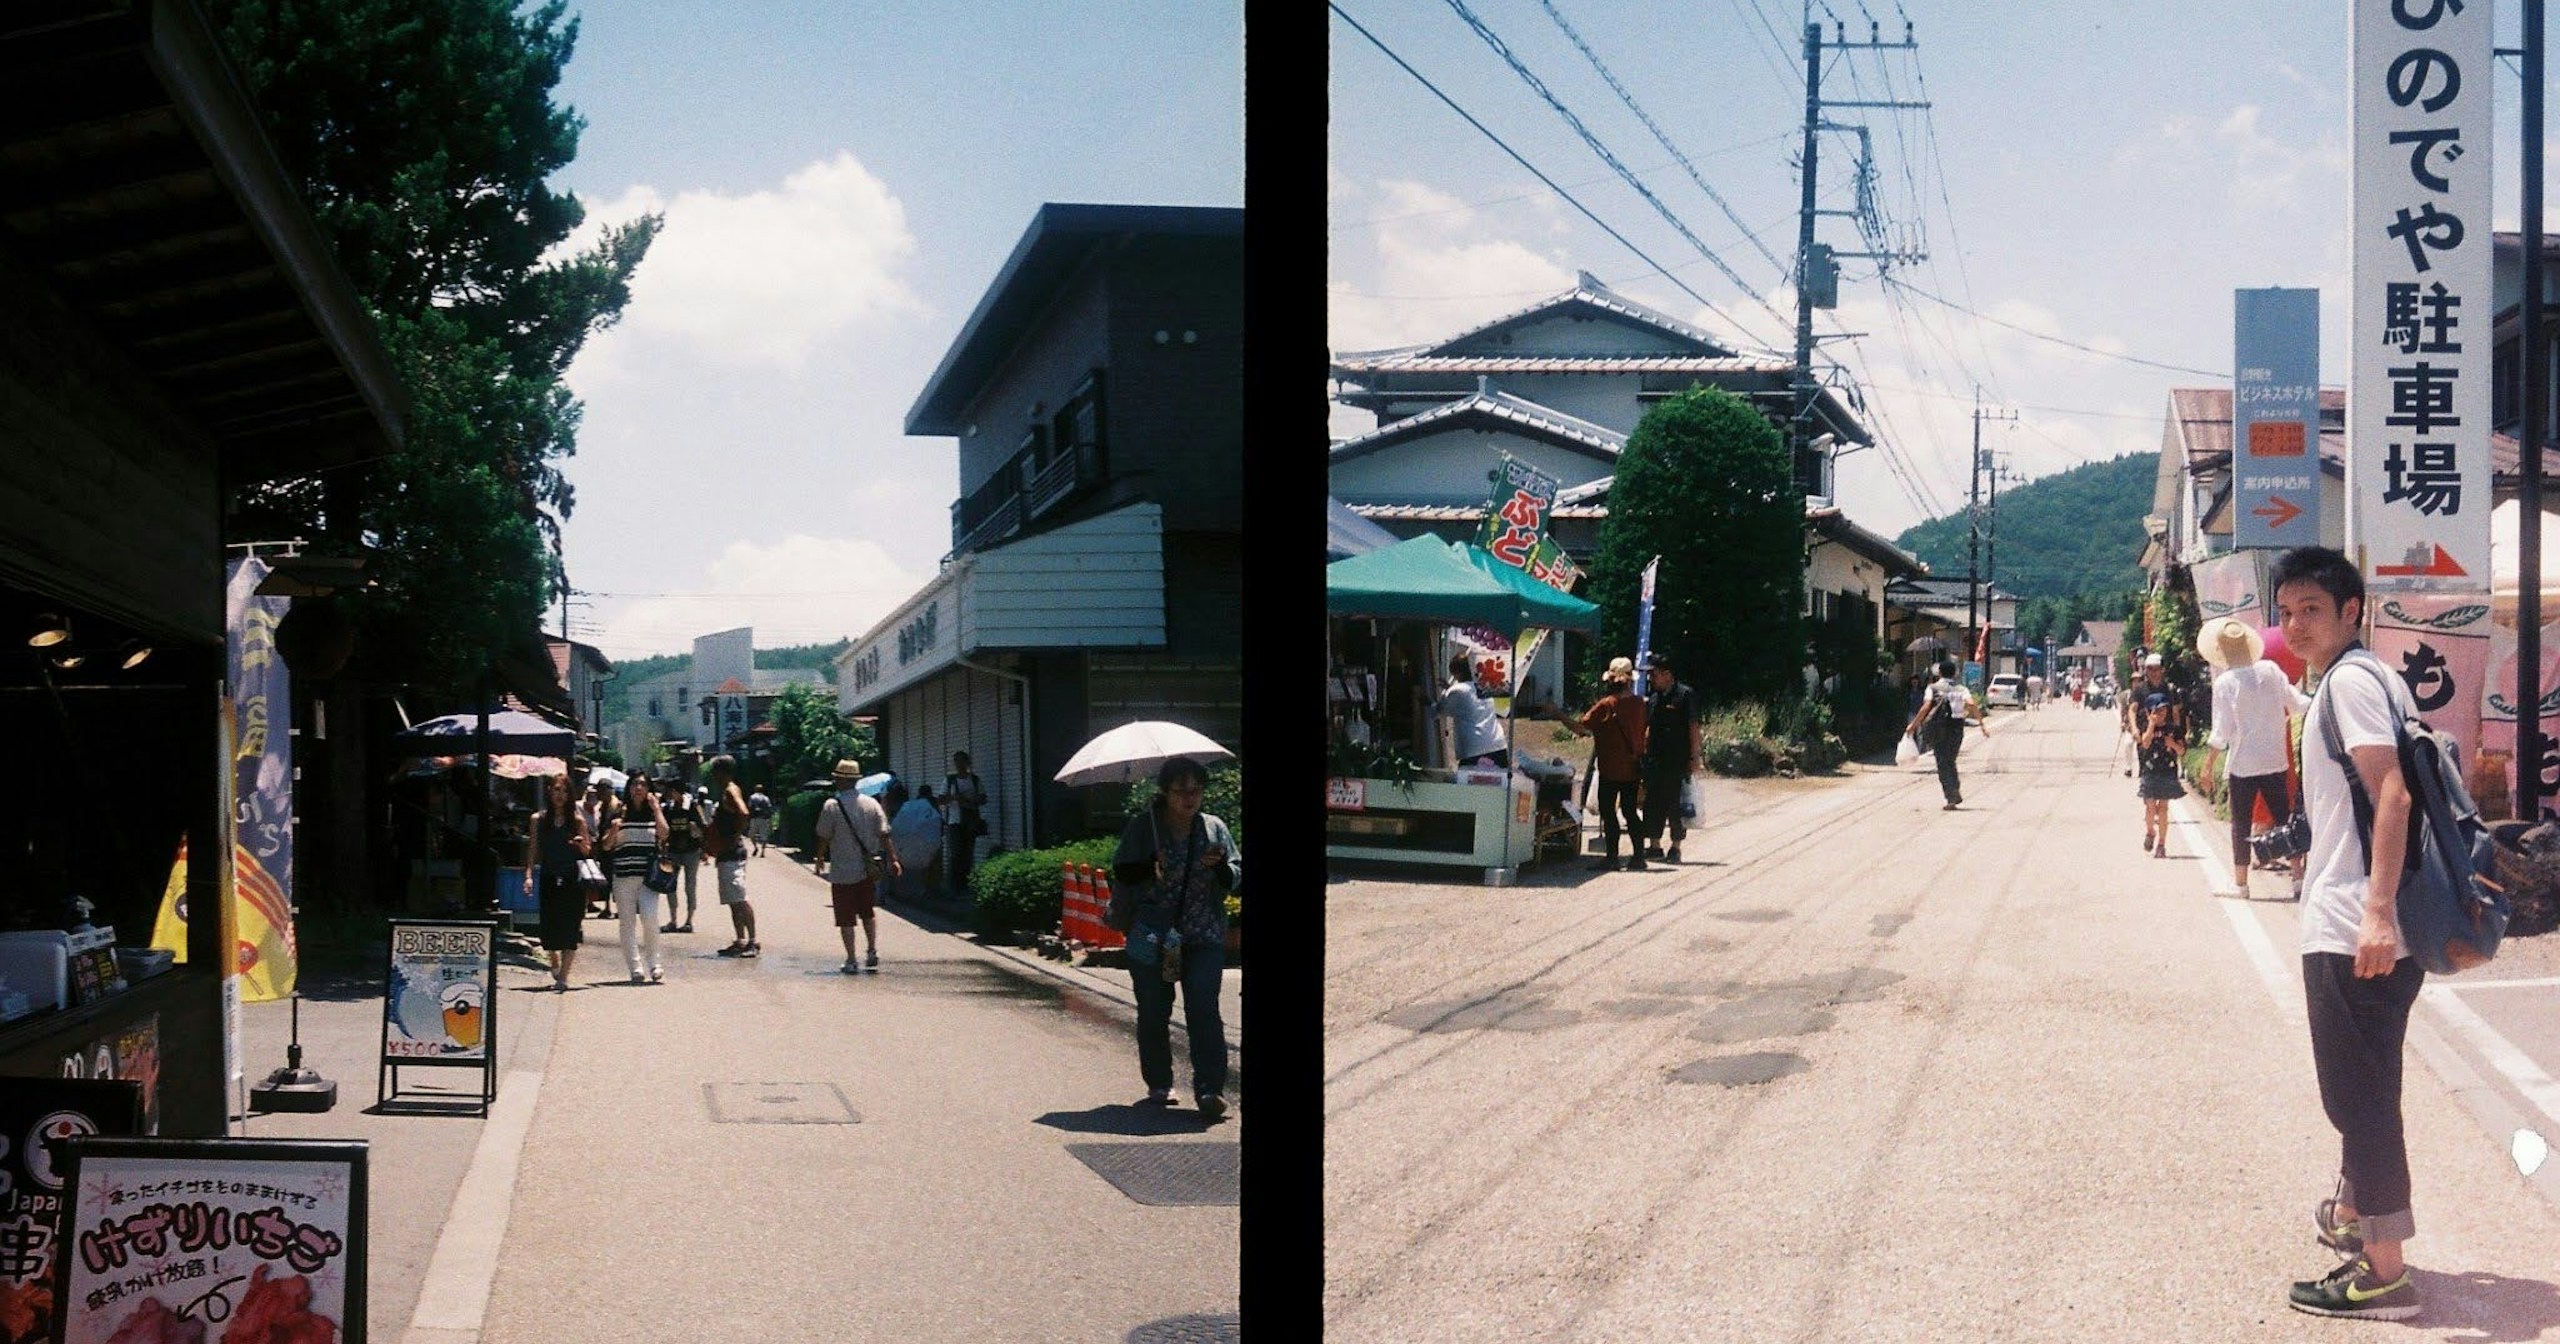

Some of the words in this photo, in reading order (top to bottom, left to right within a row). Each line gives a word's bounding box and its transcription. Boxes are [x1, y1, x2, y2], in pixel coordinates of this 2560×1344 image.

[2240, 386, 2315, 402] ビジネスホテル
[396, 930, 486, 955] BEER
[388, 1041, 439, 1056] ¥500
[79, 1201, 343, 1275] けずりいちご
